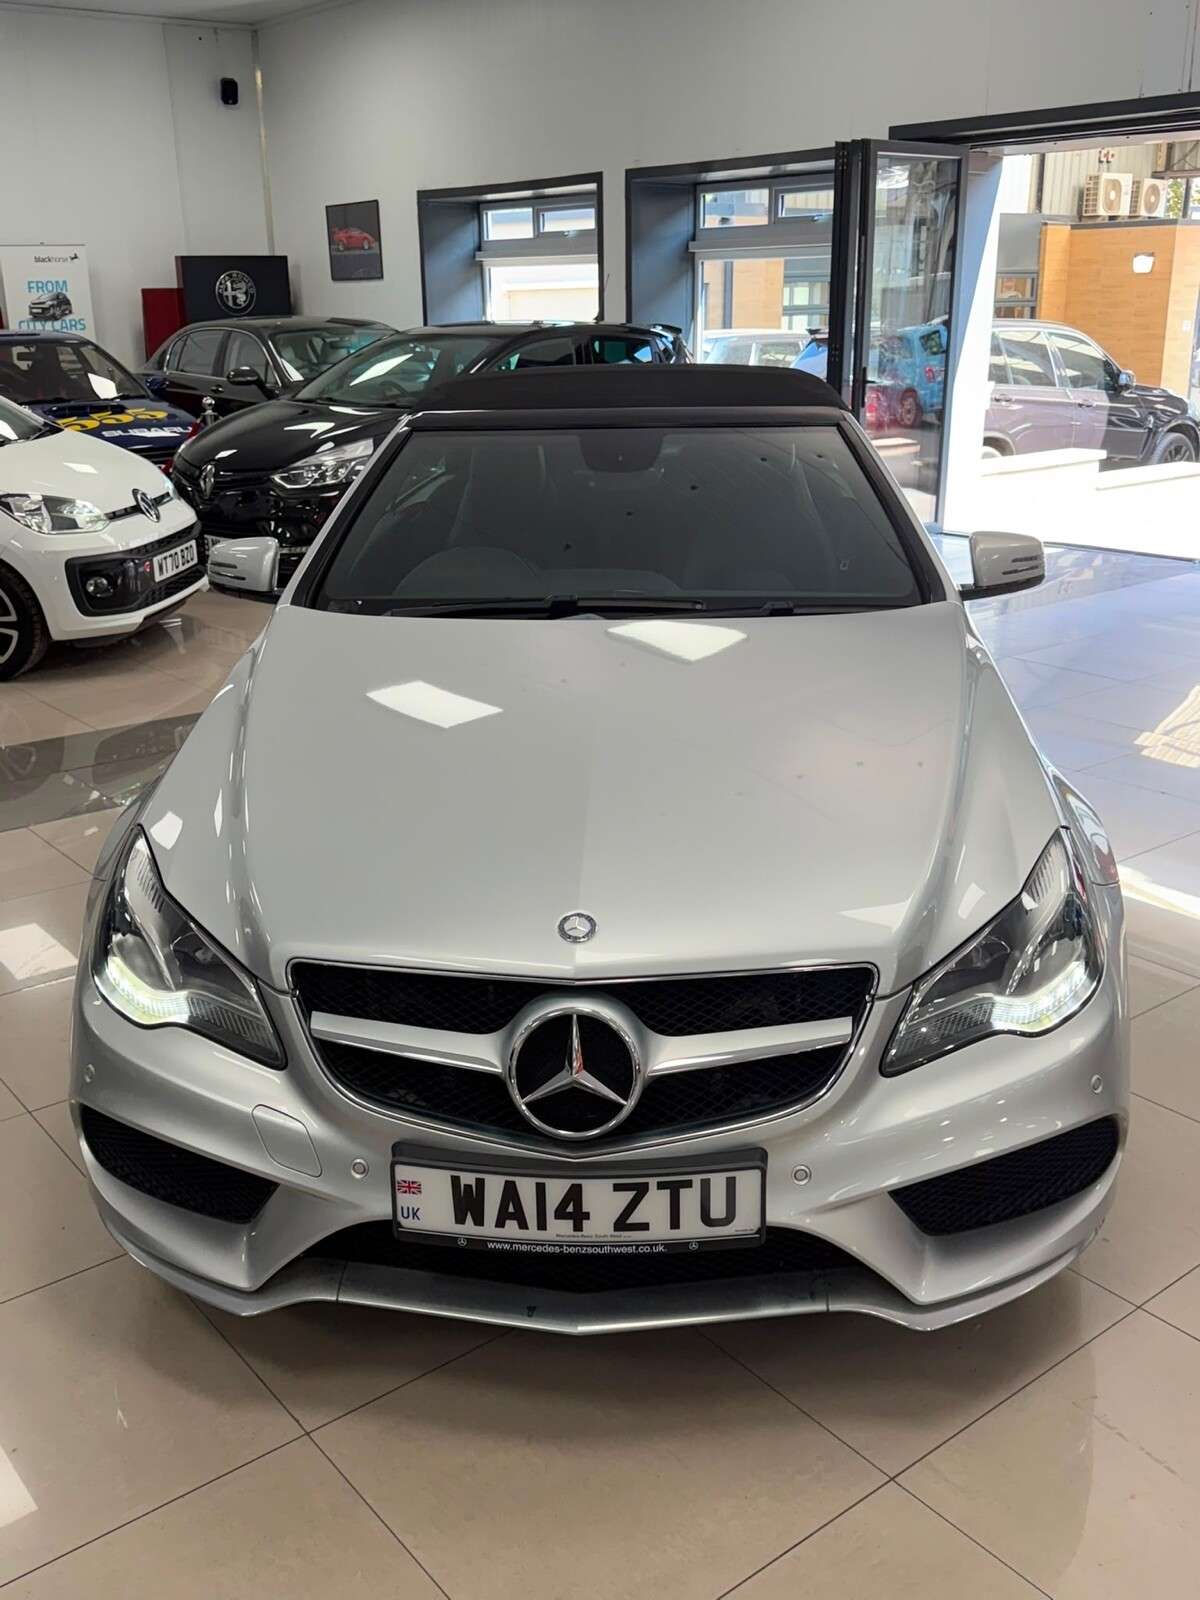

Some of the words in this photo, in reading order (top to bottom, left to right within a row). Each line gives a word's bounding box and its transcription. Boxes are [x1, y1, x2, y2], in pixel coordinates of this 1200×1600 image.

[27, 280, 68, 293] FROM
[18, 320, 48, 331] CITY
[51, 318, 87, 332] CARS
[450, 1175, 590, 1233] WA14
[612, 1176, 737, 1233] ZTU
[400, 1206, 422, 1221] UK
[487, 1241, 666, 1255] www.mercedes-benzsouthwest.co.uk
